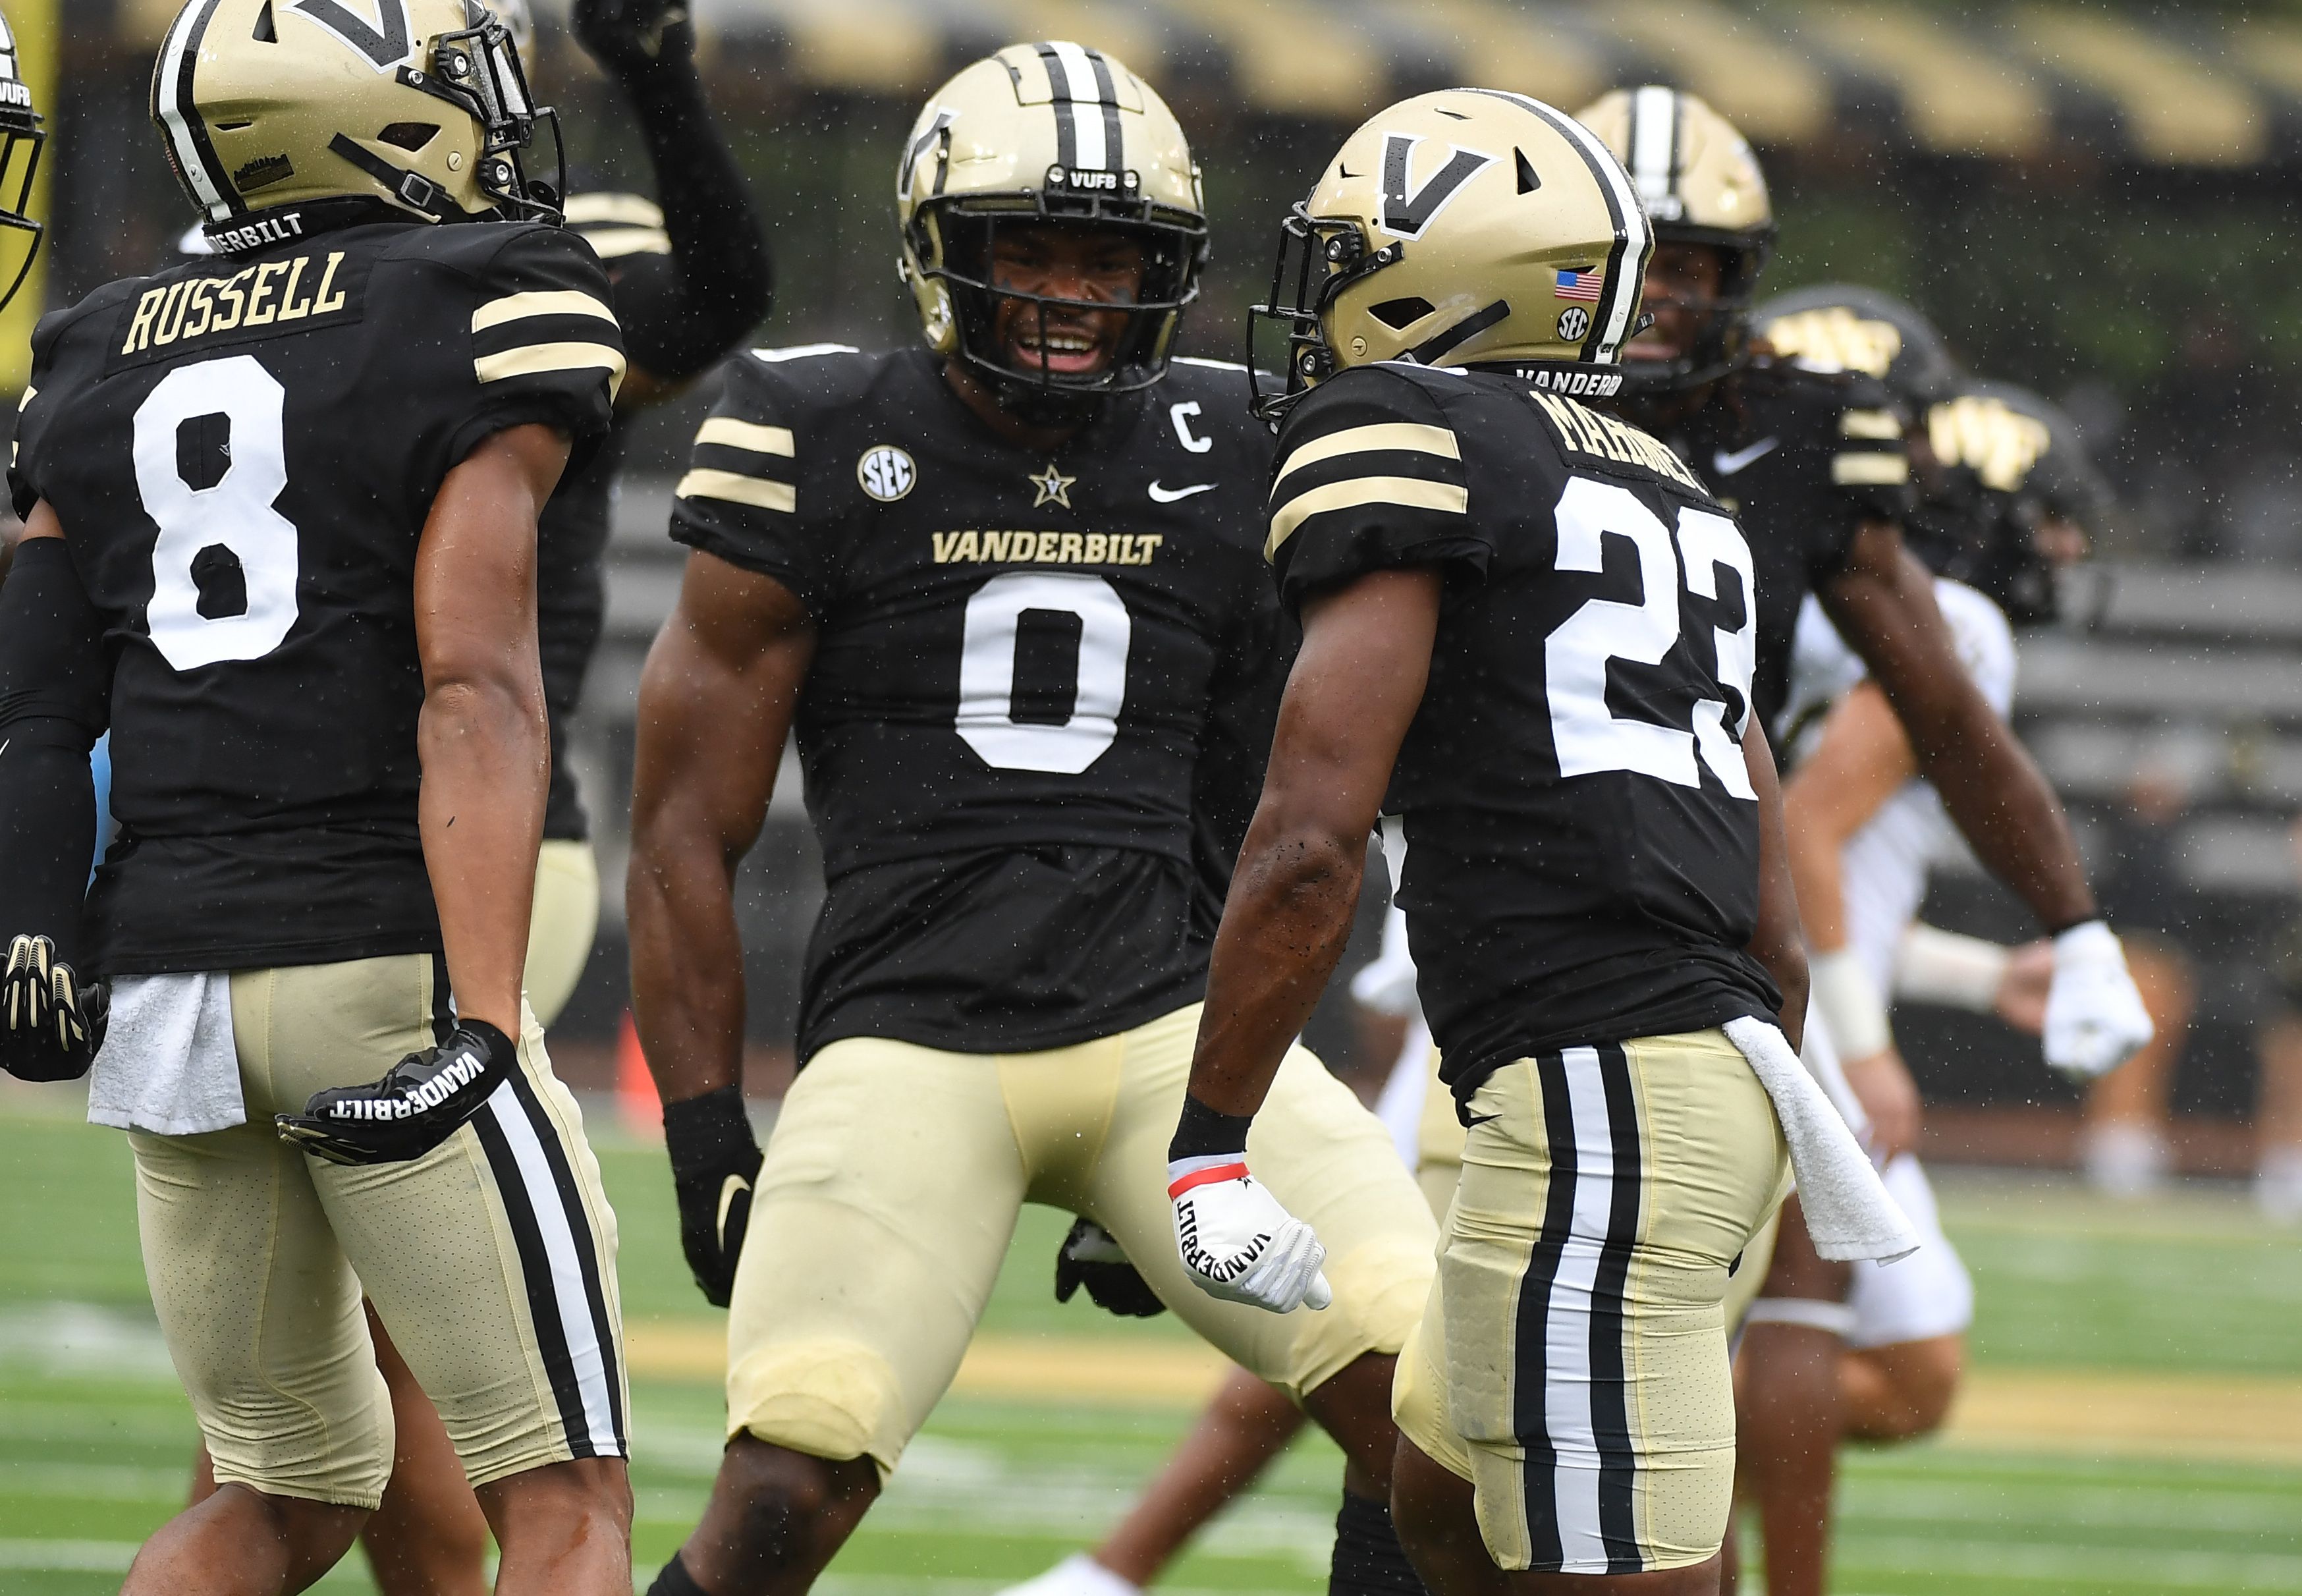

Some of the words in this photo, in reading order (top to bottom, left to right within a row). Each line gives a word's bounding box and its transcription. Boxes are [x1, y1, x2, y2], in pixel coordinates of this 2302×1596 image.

[1070, 171, 1117, 190] VUFB
[1377, 132, 1504, 241] V
[121, 251, 346, 355] RUSSELL
[1557, 307, 1588, 341] SEC
[1169, 400, 1213, 453] C
[861, 449, 913, 499] SEC
[133, 355, 299, 672] 8
[931, 530, 1164, 566] VANDERBILT
[955, 571, 1132, 775] 0
[1544, 476, 1759, 801] 23
[329, 1051, 485, 1120] VANDERBILT
[1176, 1199, 1272, 1283] VANDERBILT
